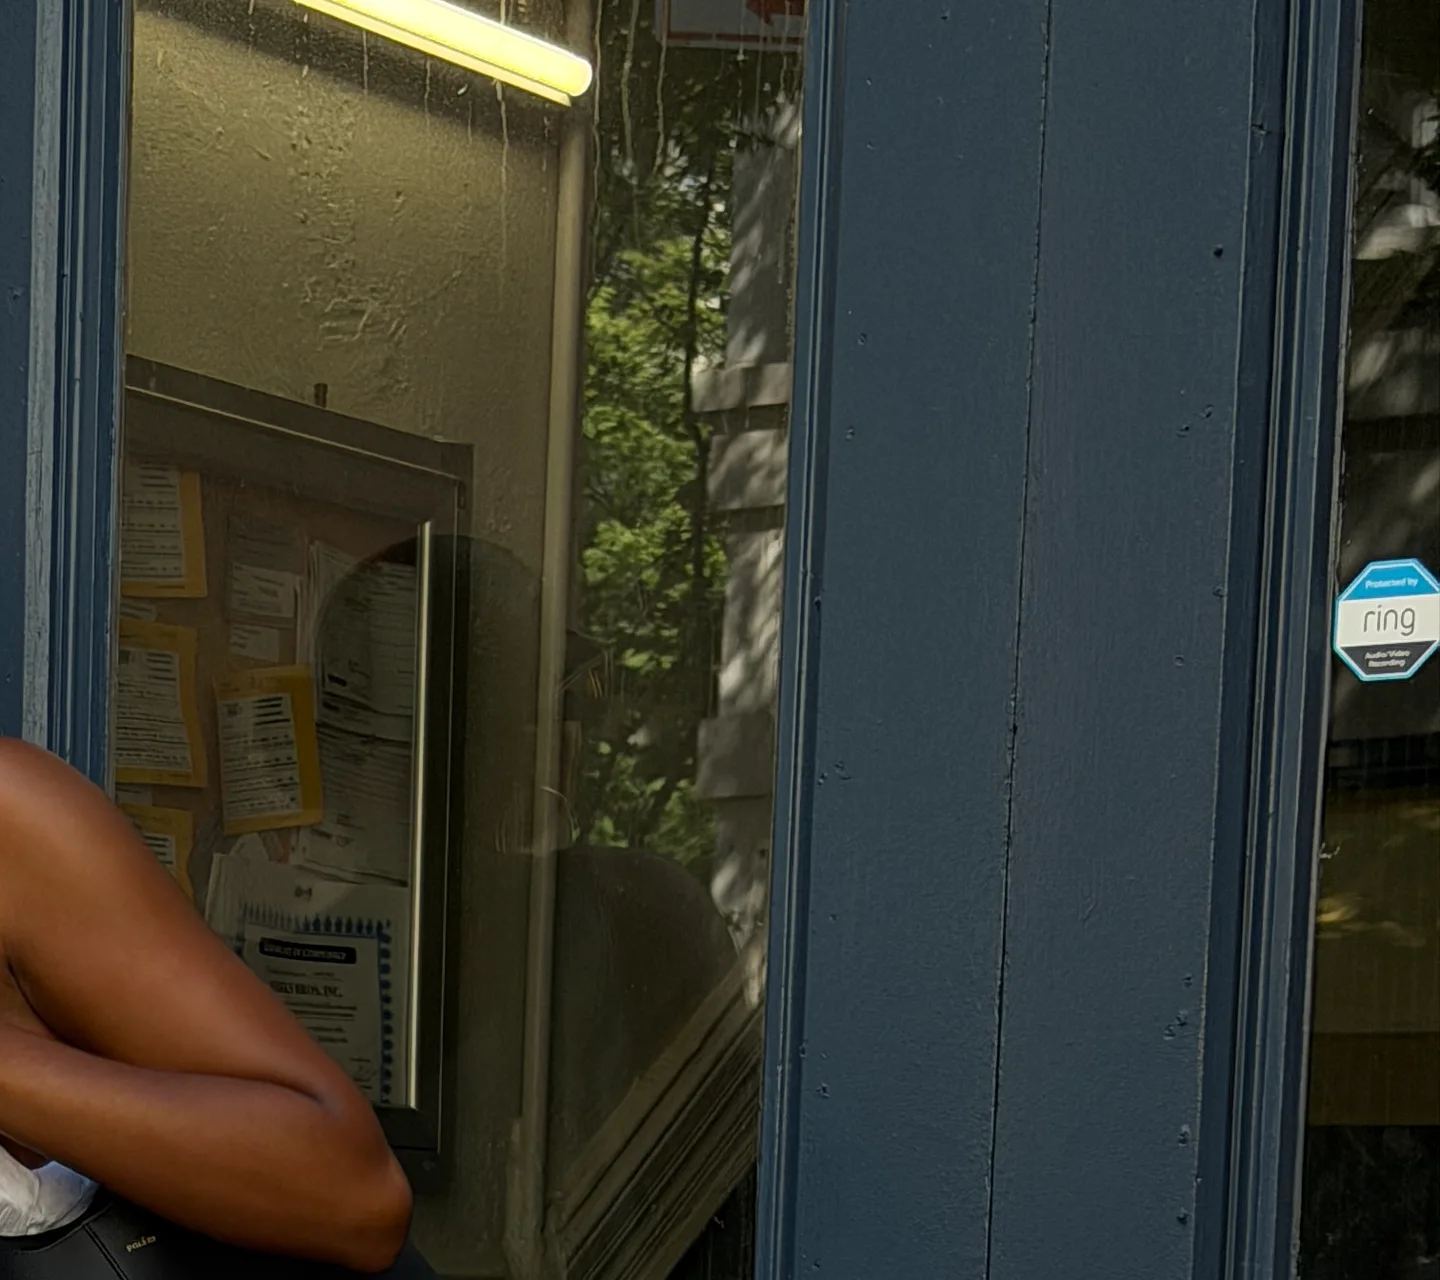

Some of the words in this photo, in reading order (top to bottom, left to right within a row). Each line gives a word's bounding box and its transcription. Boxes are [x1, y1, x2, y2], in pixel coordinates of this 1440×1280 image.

[1366, 577, 1406, 588] Protected
[1408, 576, 1418, 587] by
[1364, 605, 1415, 636] ring
